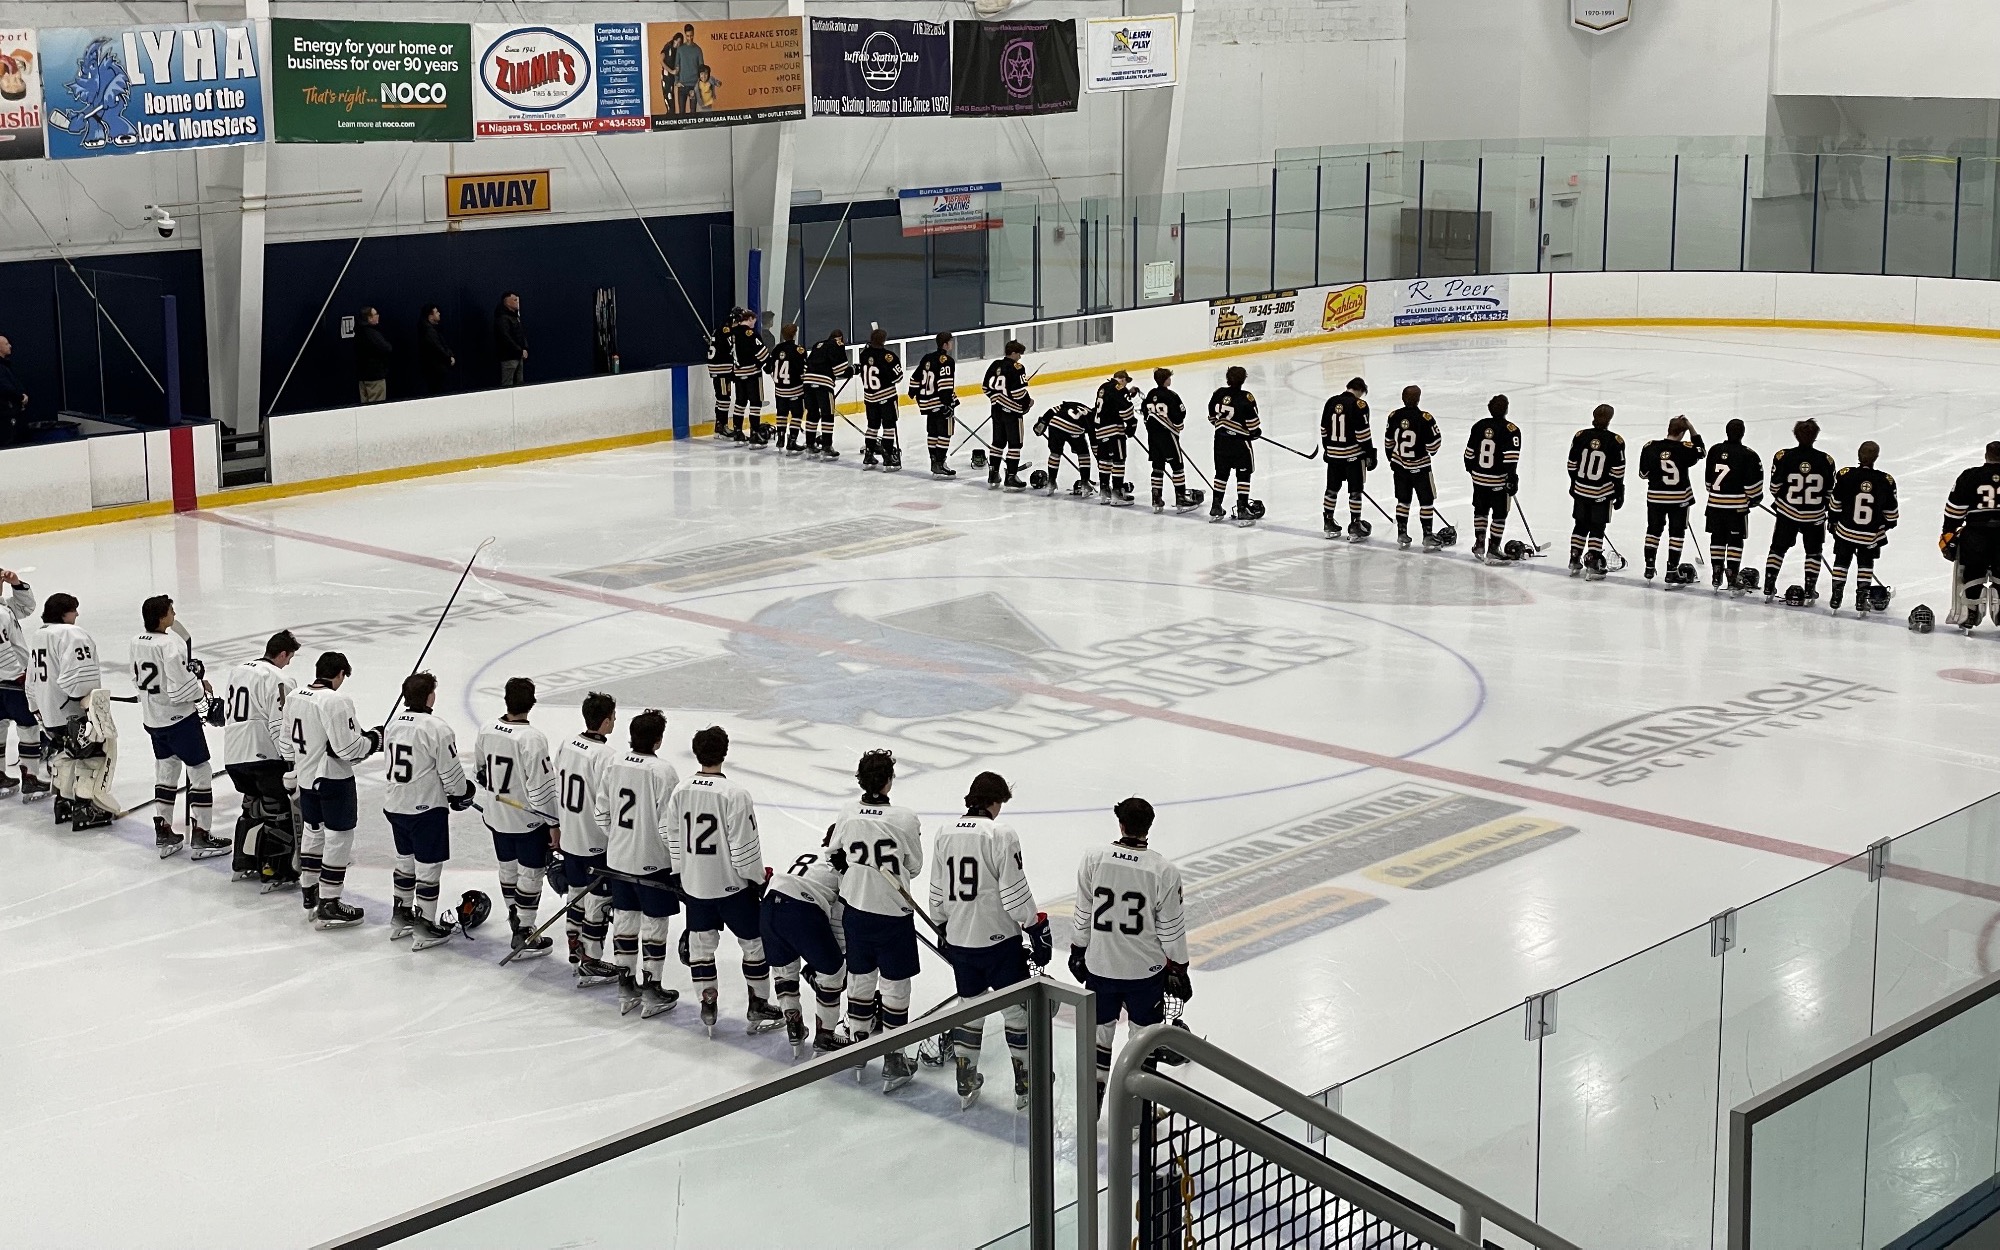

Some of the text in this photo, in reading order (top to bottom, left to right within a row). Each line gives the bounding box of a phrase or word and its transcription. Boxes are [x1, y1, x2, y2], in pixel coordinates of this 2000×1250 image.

[294, 37, 453, 57] Energy for your home or
[711, 29, 798, 41] NIKE CLEARANCE STORE
[722, 40, 799, 51] POLO RALPH LAUREN
[1129, 30, 1151, 39] LEARN
[1131, 40, 1150, 49] PLAY
[122, 27, 257, 86] LYHA
[287, 55, 459, 75] business for over 90 years
[784, 51, 800, 59] H&M
[844, 51, 919, 64] Buffalo Skating Club
[600, 66, 639, 74] Light Diagnostics
[742, 63, 801, 74] UNDER ARMOUR
[144, 88, 245, 115] Home of the
[302, 86, 337, 105] That's
[381, 82, 447, 104] NOCO
[614, 97, 640, 105] Alignments
[748, 88, 757, 96] UP
[758, 87, 770, 95] TO
[786, 84, 802, 93] OFF
[813, 96, 840, 115] Bringing
[841, 96, 865, 114] Skating
[866, 97, 891, 112] Dreams
[899, 97, 912, 113] Life
[912, 97, 931, 113] Since
[179, 115, 257, 140] Monsters
[338, 120, 356, 128] Learn
[488, 121, 522, 134] Niagara
[523, 121, 538, 132] St.,
[540, 119, 580, 132] Lockport,
[582, 121, 593, 129] NY
[609, 118, 646, 128] 434-5539
[460, 179, 537, 209] AWAY
[1408, 279, 1495, 300] R. Peer
[773, 359, 790, 385] 14
[863, 364, 881, 390] 16
[939, 366, 951, 376] 20
[1331, 413, 1347, 443] 11
[1512, 435, 1520, 446] 8
[1394, 428, 1417, 459] 12
[1479, 438, 1496, 469] 8
[1577, 448, 1606, 481] 10
[1660, 459, 1680, 486] 9
[1711, 463, 1731, 491] 7
[1786, 473, 1824, 505] 22
[1853, 492, 1875, 525] 6
[74, 645, 91, 661] 35
[291, 718, 307, 755] 4
[348, 717, 355, 732] 4
[1499, 674, 1857, 778] HEINRICH
[1648, 685, 1898, 769] CHEVROLET
[386, 742, 413, 784] 15
[486, 754, 514, 794] 17
[560, 769, 585, 815] 10
[618, 787, 636, 830] 2
[1275, 789, 1440, 842] FRONTIER
[684, 811, 718, 855] 12
[946, 856, 979, 902] 19
[1093, 886, 1147, 936] 23
